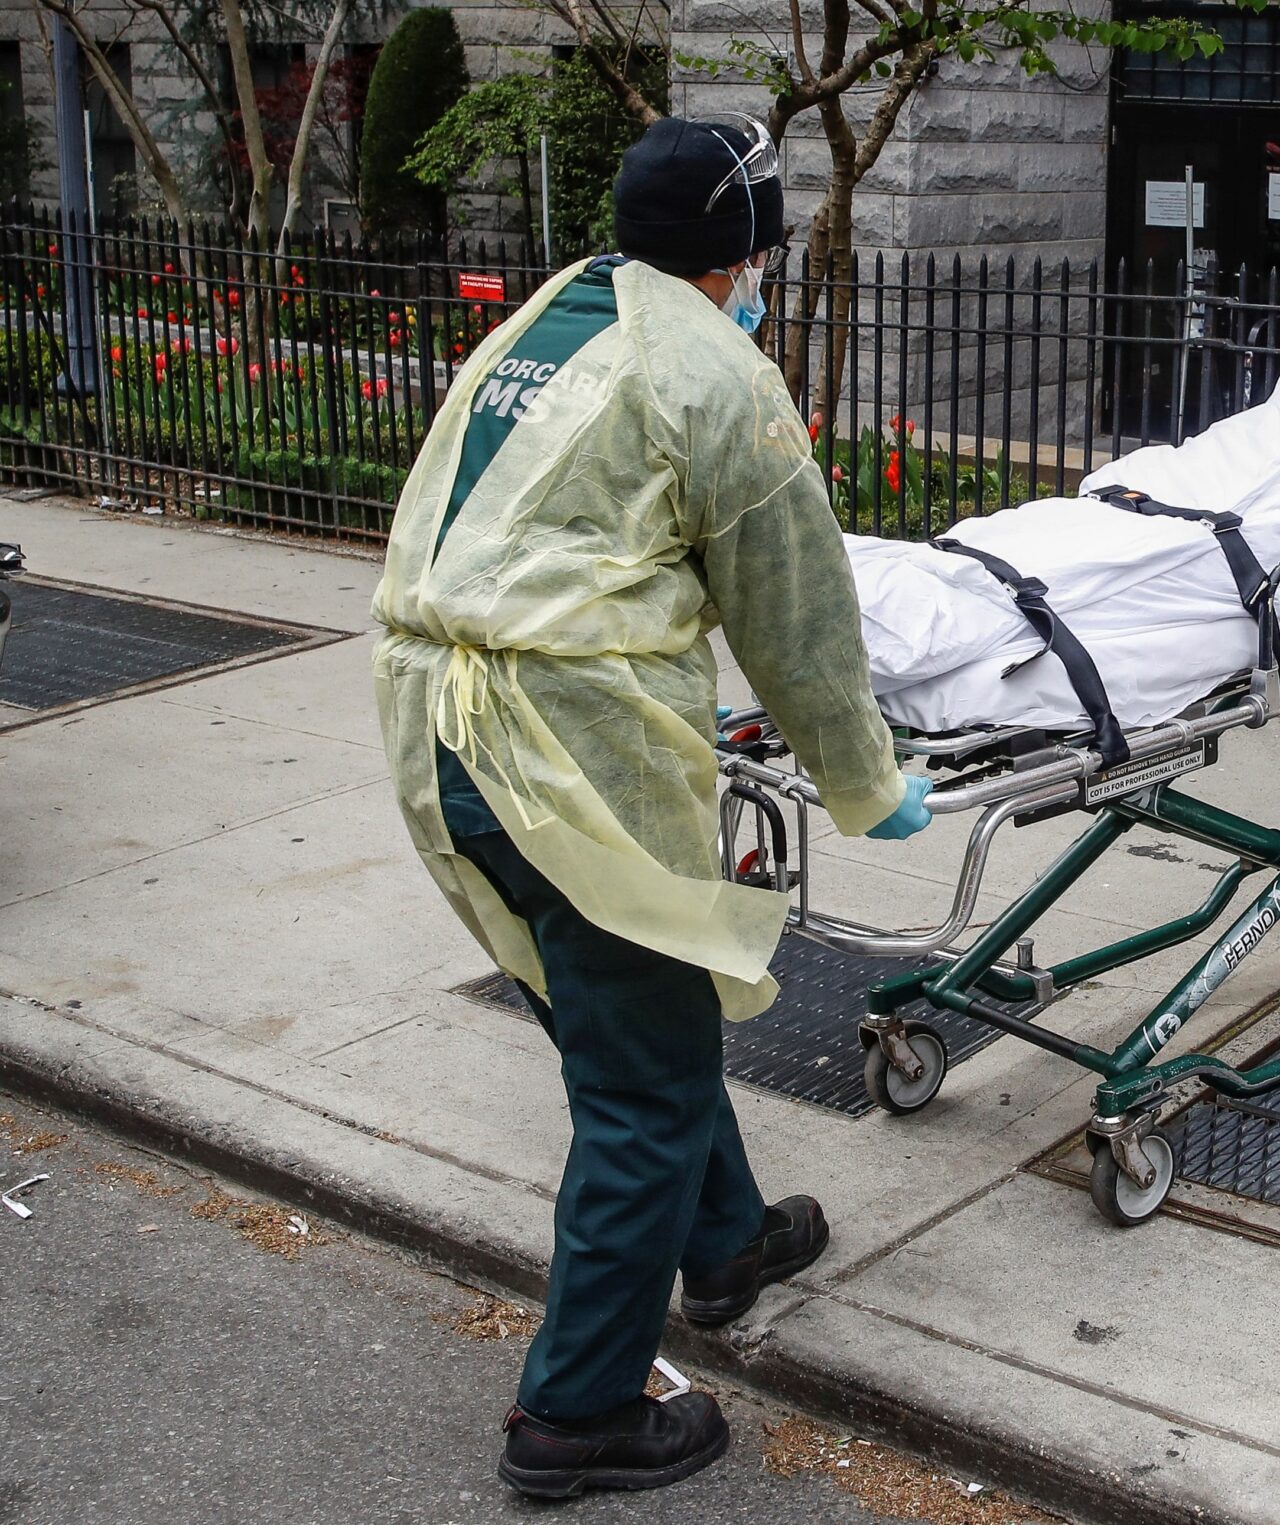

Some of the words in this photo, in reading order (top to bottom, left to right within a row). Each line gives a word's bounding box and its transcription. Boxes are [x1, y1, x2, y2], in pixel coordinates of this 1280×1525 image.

[473, 377, 556, 424] MS
[1090, 787, 1103, 798] COT
[1103, 784, 1111, 793] IS
[1111, 780, 1125, 791] FOR
[1125, 766, 1172, 787] PROFESSIONAL
[1172, 760, 1185, 771] USE
[1184, 755, 1201, 767] ONLY
[1108, 770, 1117, 779] DO
[1117, 767, 1128, 776] NOT
[1127, 762, 1148, 772] REMOVE
[1148, 757, 1160, 766] THIS
[1160, 753, 1174, 762] HAND
[1174, 746, 1191, 757] GUARD
[1224, 908, 1275, 970] FERNO
